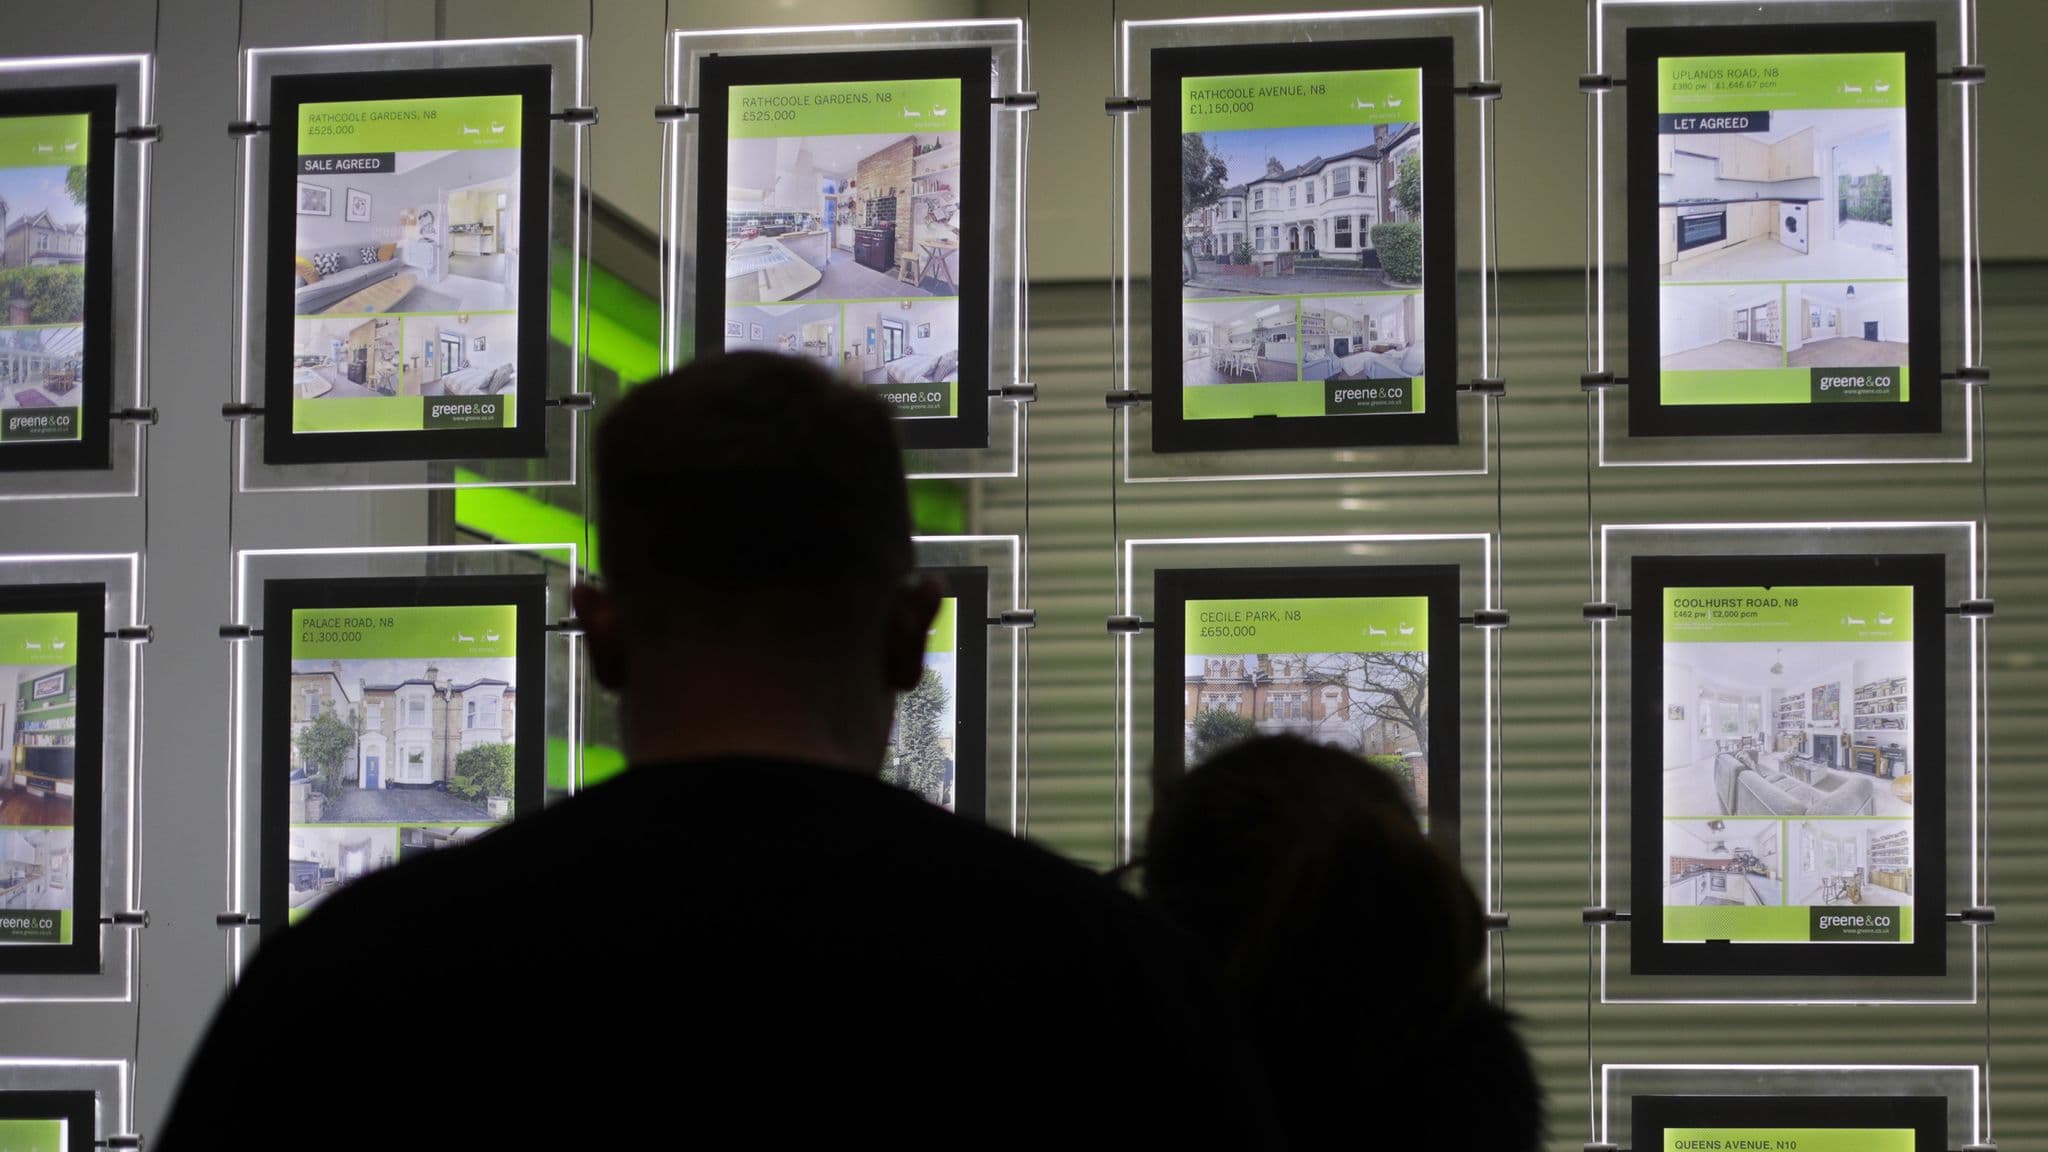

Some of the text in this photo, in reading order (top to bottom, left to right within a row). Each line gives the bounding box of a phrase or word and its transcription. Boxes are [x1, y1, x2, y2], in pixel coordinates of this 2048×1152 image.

[1672, 67, 1780, 80] UPLANDS ROAD, N8
[1190, 83, 1327, 101] RATHCOOLE AVENUE, N8
[742, 92, 893, 107] RATHCOOLE GARDENS, N8
[1190, 102, 1254, 115] £1,150,000
[308, 110, 437, 123] RATHCOOLE GARDENS, N8
[742, 110, 796, 121] £525,000
[308, 124, 354, 135] £525,000
[1674, 117, 1749, 130] LET AGREED
[304, 158, 380, 171] SALE AGREED
[1820, 375, 1891, 391] greene&co
[880, 392, 942, 404] reene&co
[1334, 387, 1403, 403] greene&co
[432, 403, 496, 418] greene&co
[9, 415, 70, 430] greene&co
[1674, 597, 1799, 608] COOLHURST ROAD, N8
[1200, 610, 1301, 623] CECILE PARK, N8
[1740, 610, 1758, 619] pcm
[302, 617, 394, 628] PALACE ROAD, N8
[302, 631, 362, 643] £1,300,000
[1200, 626, 1256, 637] £650,000
[0, 917, 53, 929] reene&co
[1819, 914, 1891, 930] greene&co
[1674, 1140, 1797, 1150] QUEENS AVENUE, N10
